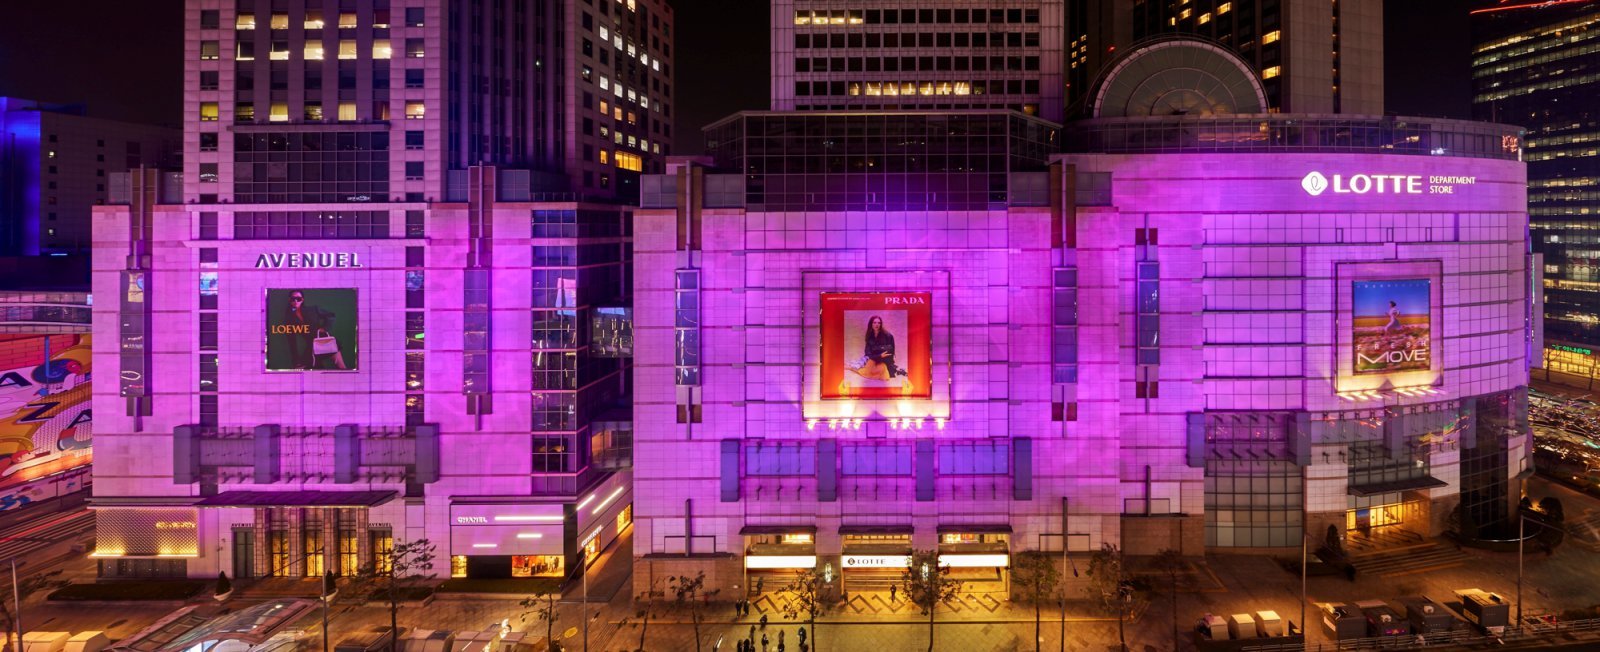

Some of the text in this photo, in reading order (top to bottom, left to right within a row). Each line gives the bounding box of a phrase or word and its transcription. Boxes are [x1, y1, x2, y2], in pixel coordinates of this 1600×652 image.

[1333, 174, 1476, 194] LOTTE DEPARTMENT
[1429, 185, 1453, 194] STORE
[255, 252, 362, 269] AVENUEL
[884, 296, 925, 305] PRADA
[271, 324, 310, 334] LOEWE
[1357, 348, 1427, 365] MOVE
[457, 516, 488, 524] CHANEL
